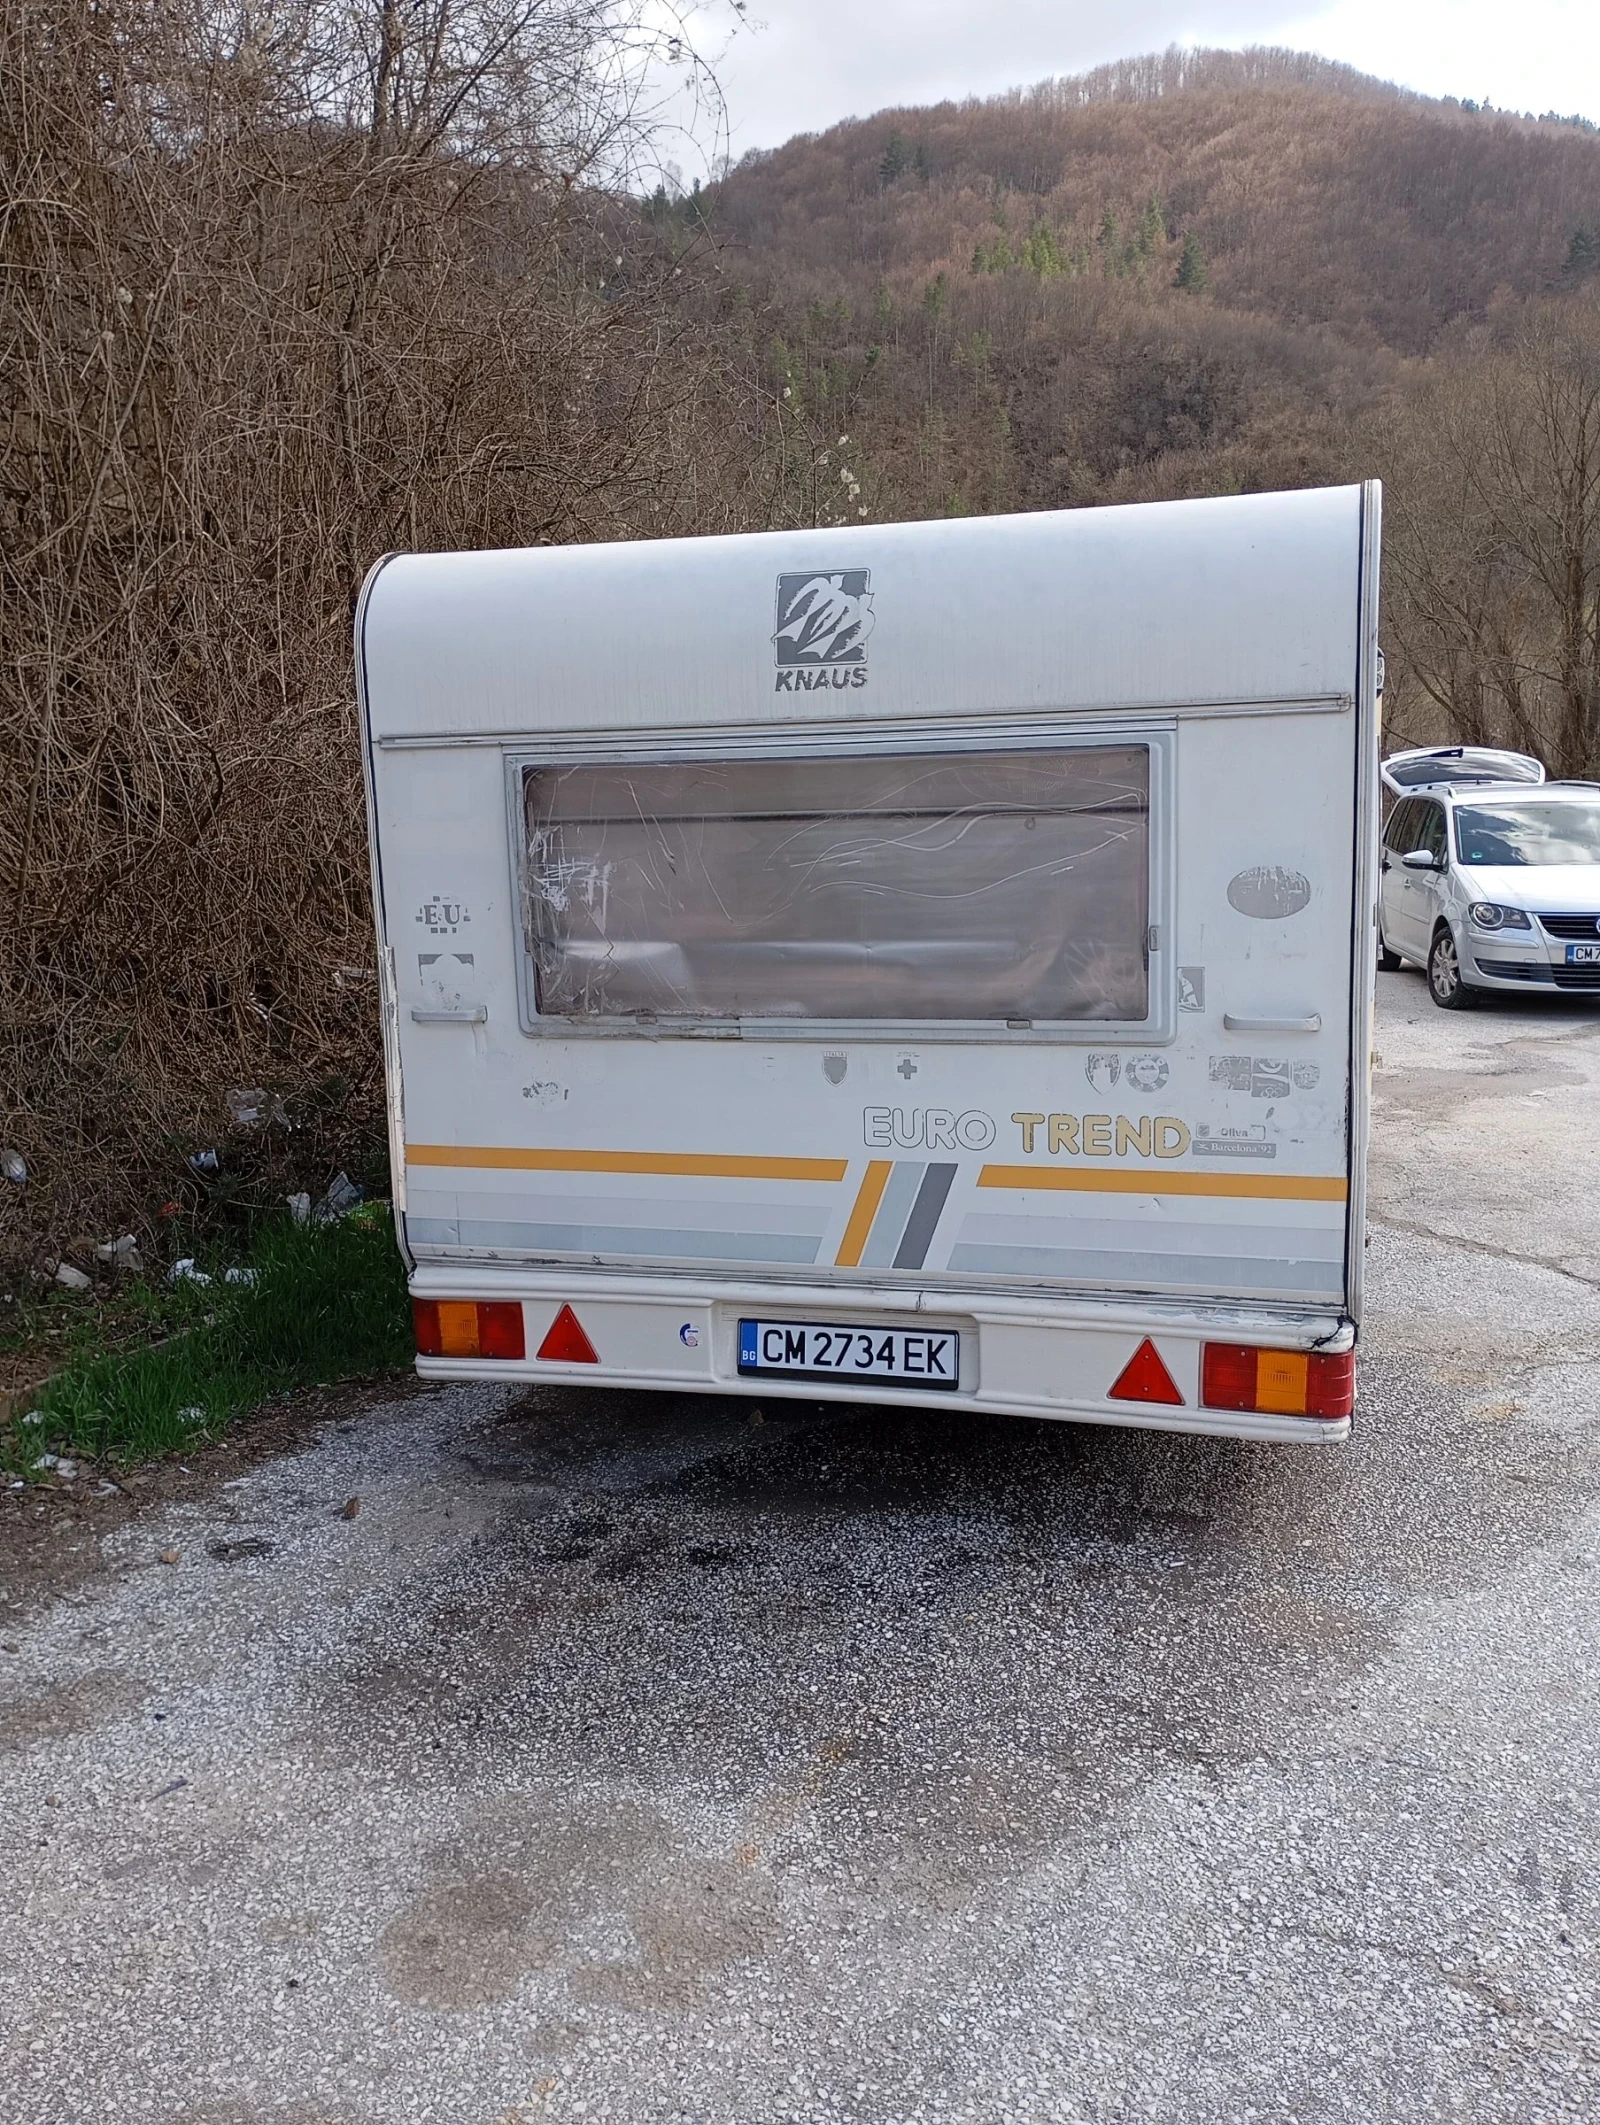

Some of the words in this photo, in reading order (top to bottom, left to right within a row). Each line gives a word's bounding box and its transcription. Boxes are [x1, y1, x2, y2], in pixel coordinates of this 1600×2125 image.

[775, 667, 868, 692] KNAUS
[863, 1106, 996, 1151] EURO
[1011, 1112, 1191, 1159] TREND
[742, 1350, 756, 1361] BG
